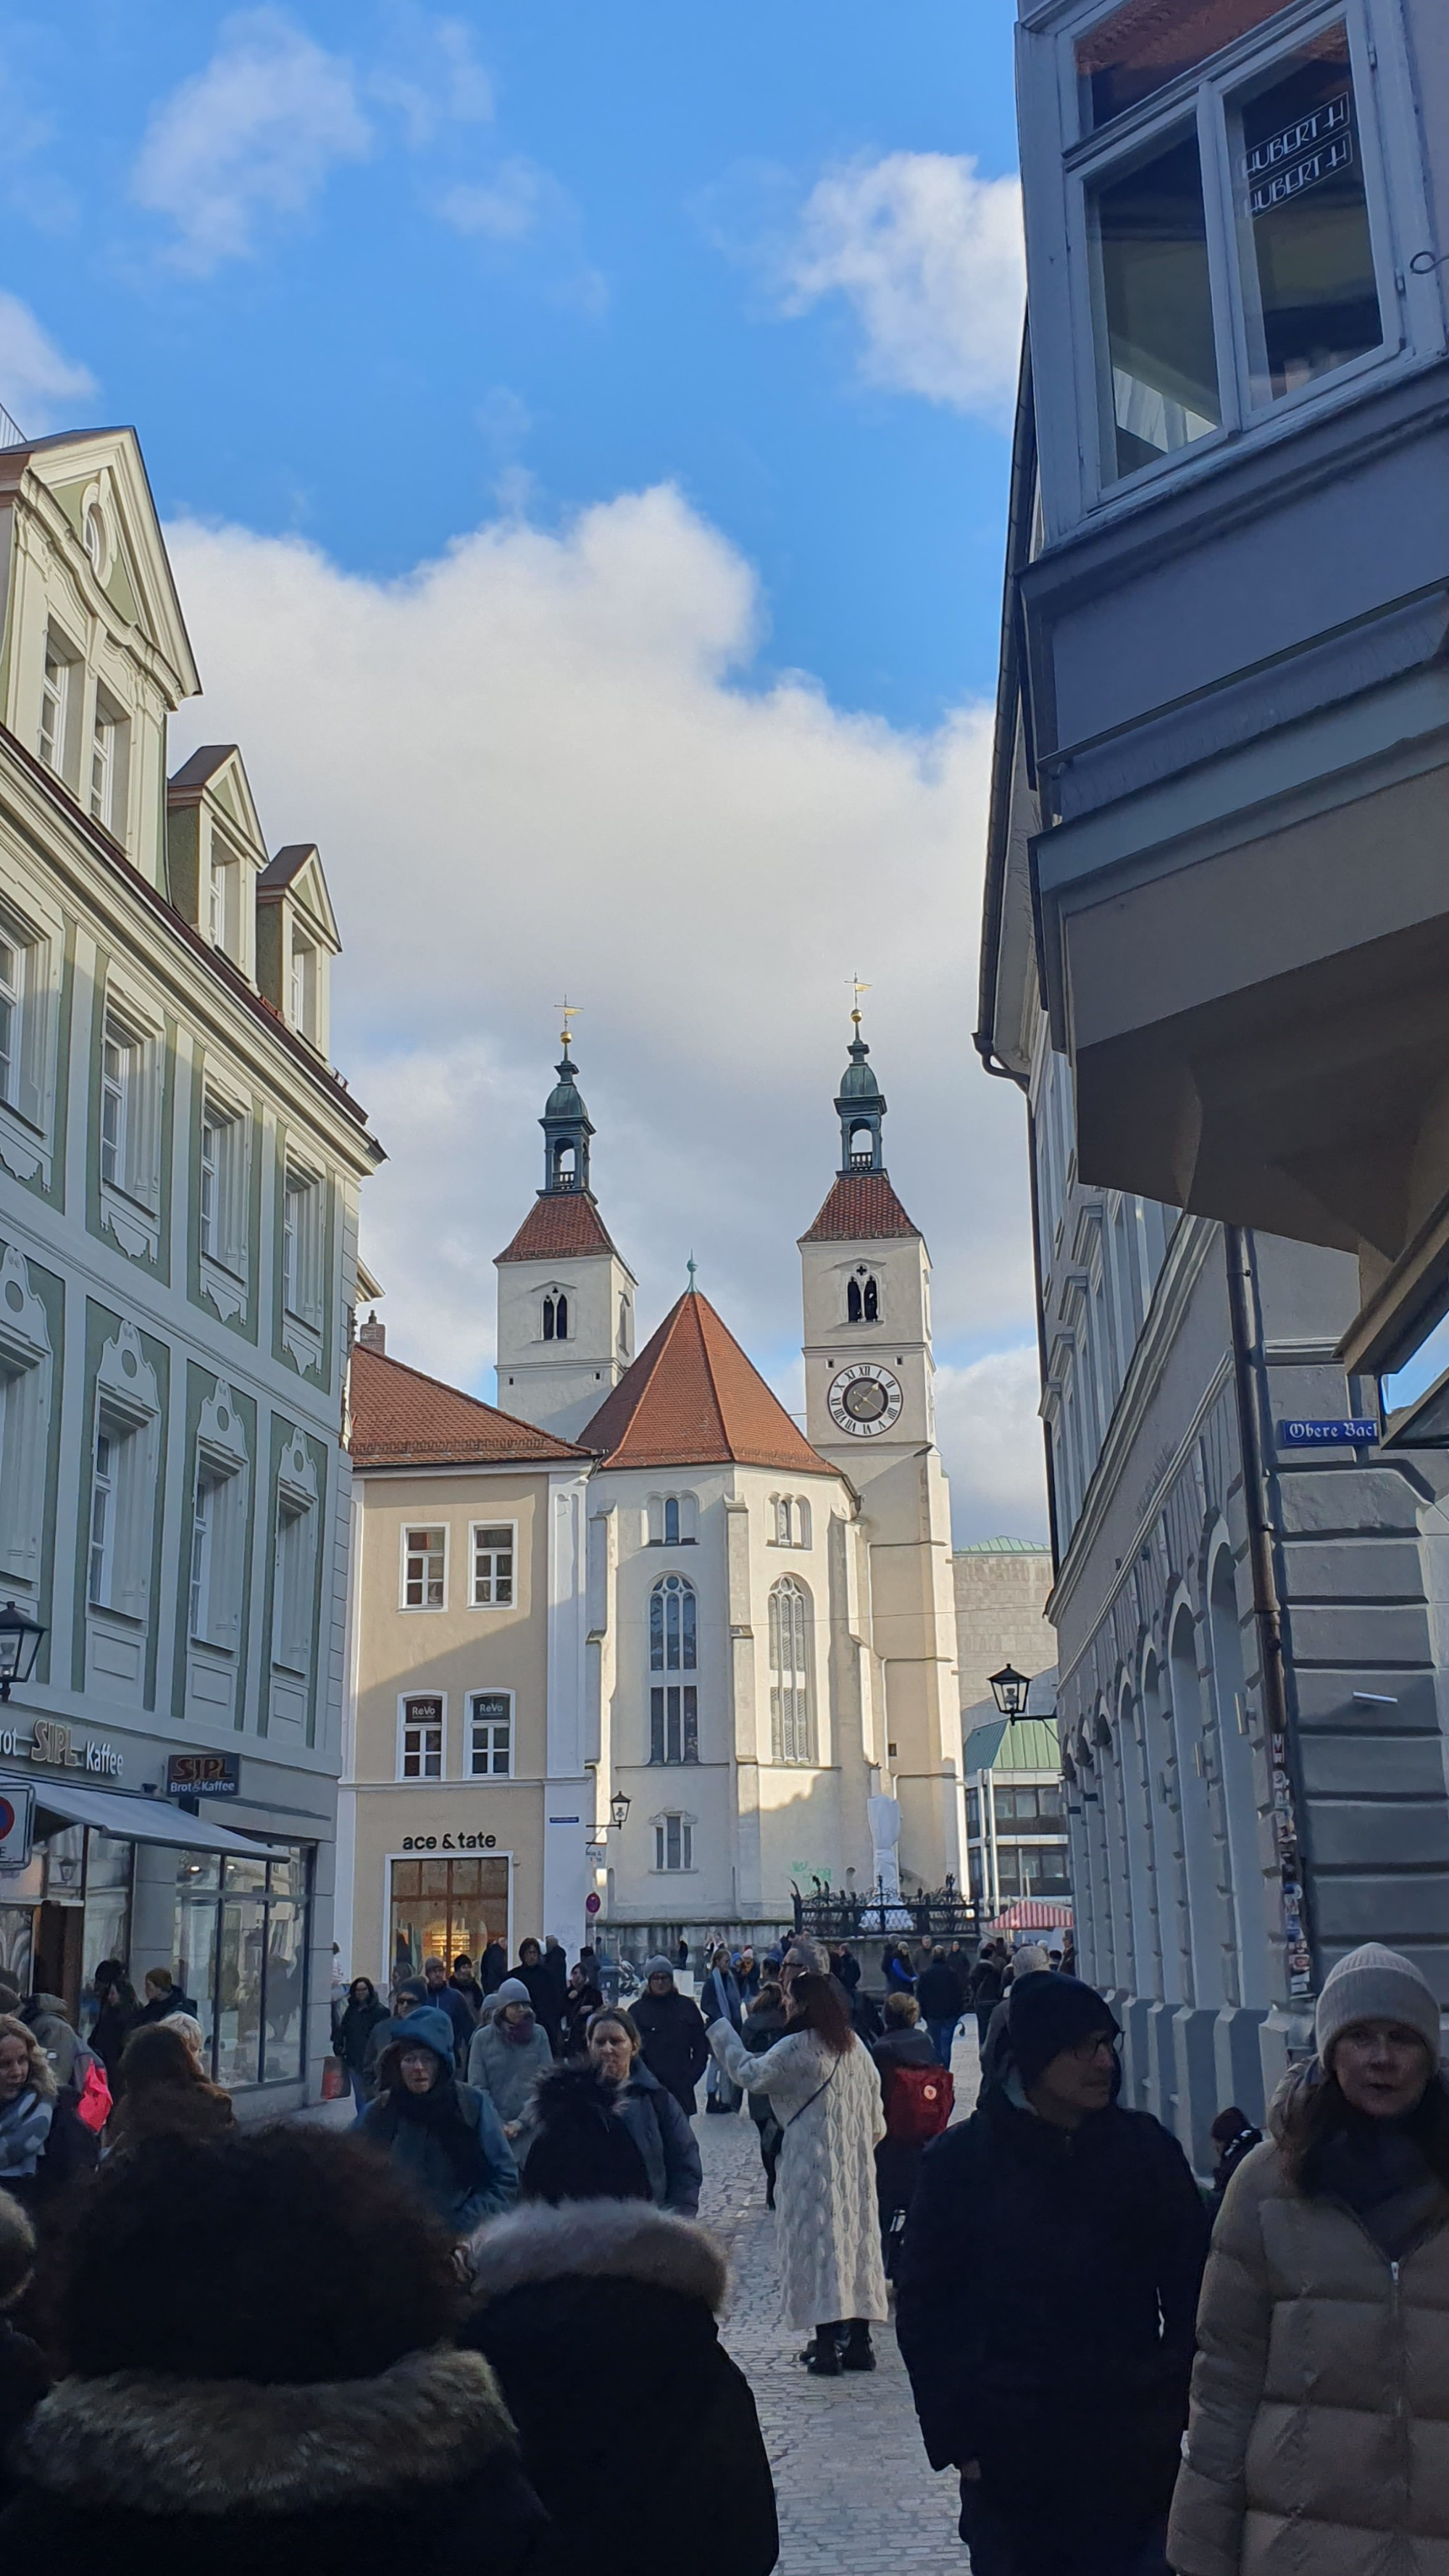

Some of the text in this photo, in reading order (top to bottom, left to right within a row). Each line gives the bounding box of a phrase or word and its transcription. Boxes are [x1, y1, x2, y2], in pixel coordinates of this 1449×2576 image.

[1242, 113, 1321, 179] HUBERT
[1244, 153, 1324, 217] HUBERT
[844, 1369, 856, 1382] XI
[859, 1366, 871, 1376] XII
[876, 1370, 882, 1379] I
[834, 1382, 845, 1391] X
[885, 1380, 896, 1388] II
[890, 1394, 900, 1403] III
[878, 1420, 886, 1430] V
[1290, 1423, 1338, 1438] Obere
[412, 1706, 435, 1715] ReVo
[480, 1703, 504, 1712] ReVo
[31, 1720, 78, 1767] SIPL
[86, 1741, 124, 1775] Kaffee
[172, 1757, 235, 1781] SIPL
[170, 1782, 192, 1793] Brot
[201, 1780, 235, 1792] Kaffee
[403, 1831, 496, 1850] ace & tate
